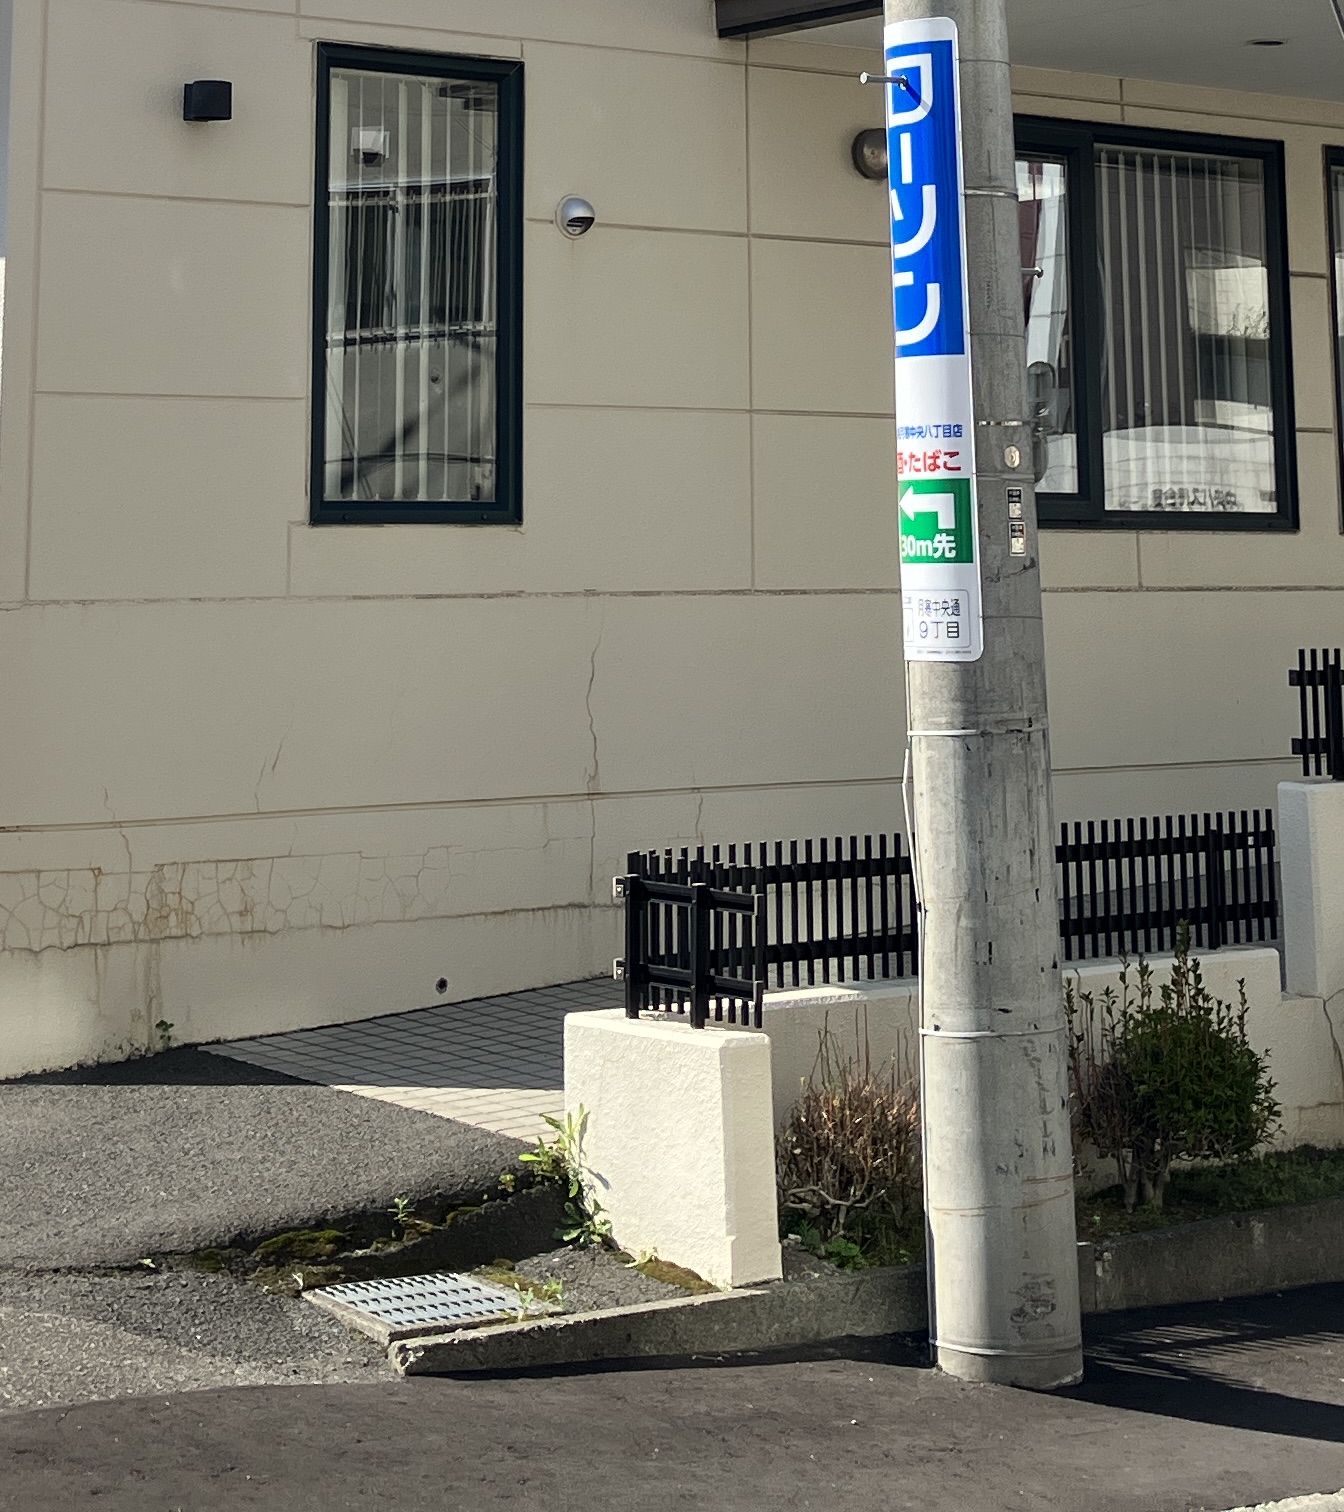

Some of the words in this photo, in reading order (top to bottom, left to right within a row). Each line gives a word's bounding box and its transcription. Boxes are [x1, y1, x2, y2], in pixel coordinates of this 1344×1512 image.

[887, 52, 941, 347] ローソン
[919, 620, 960, 639] 9丁目
